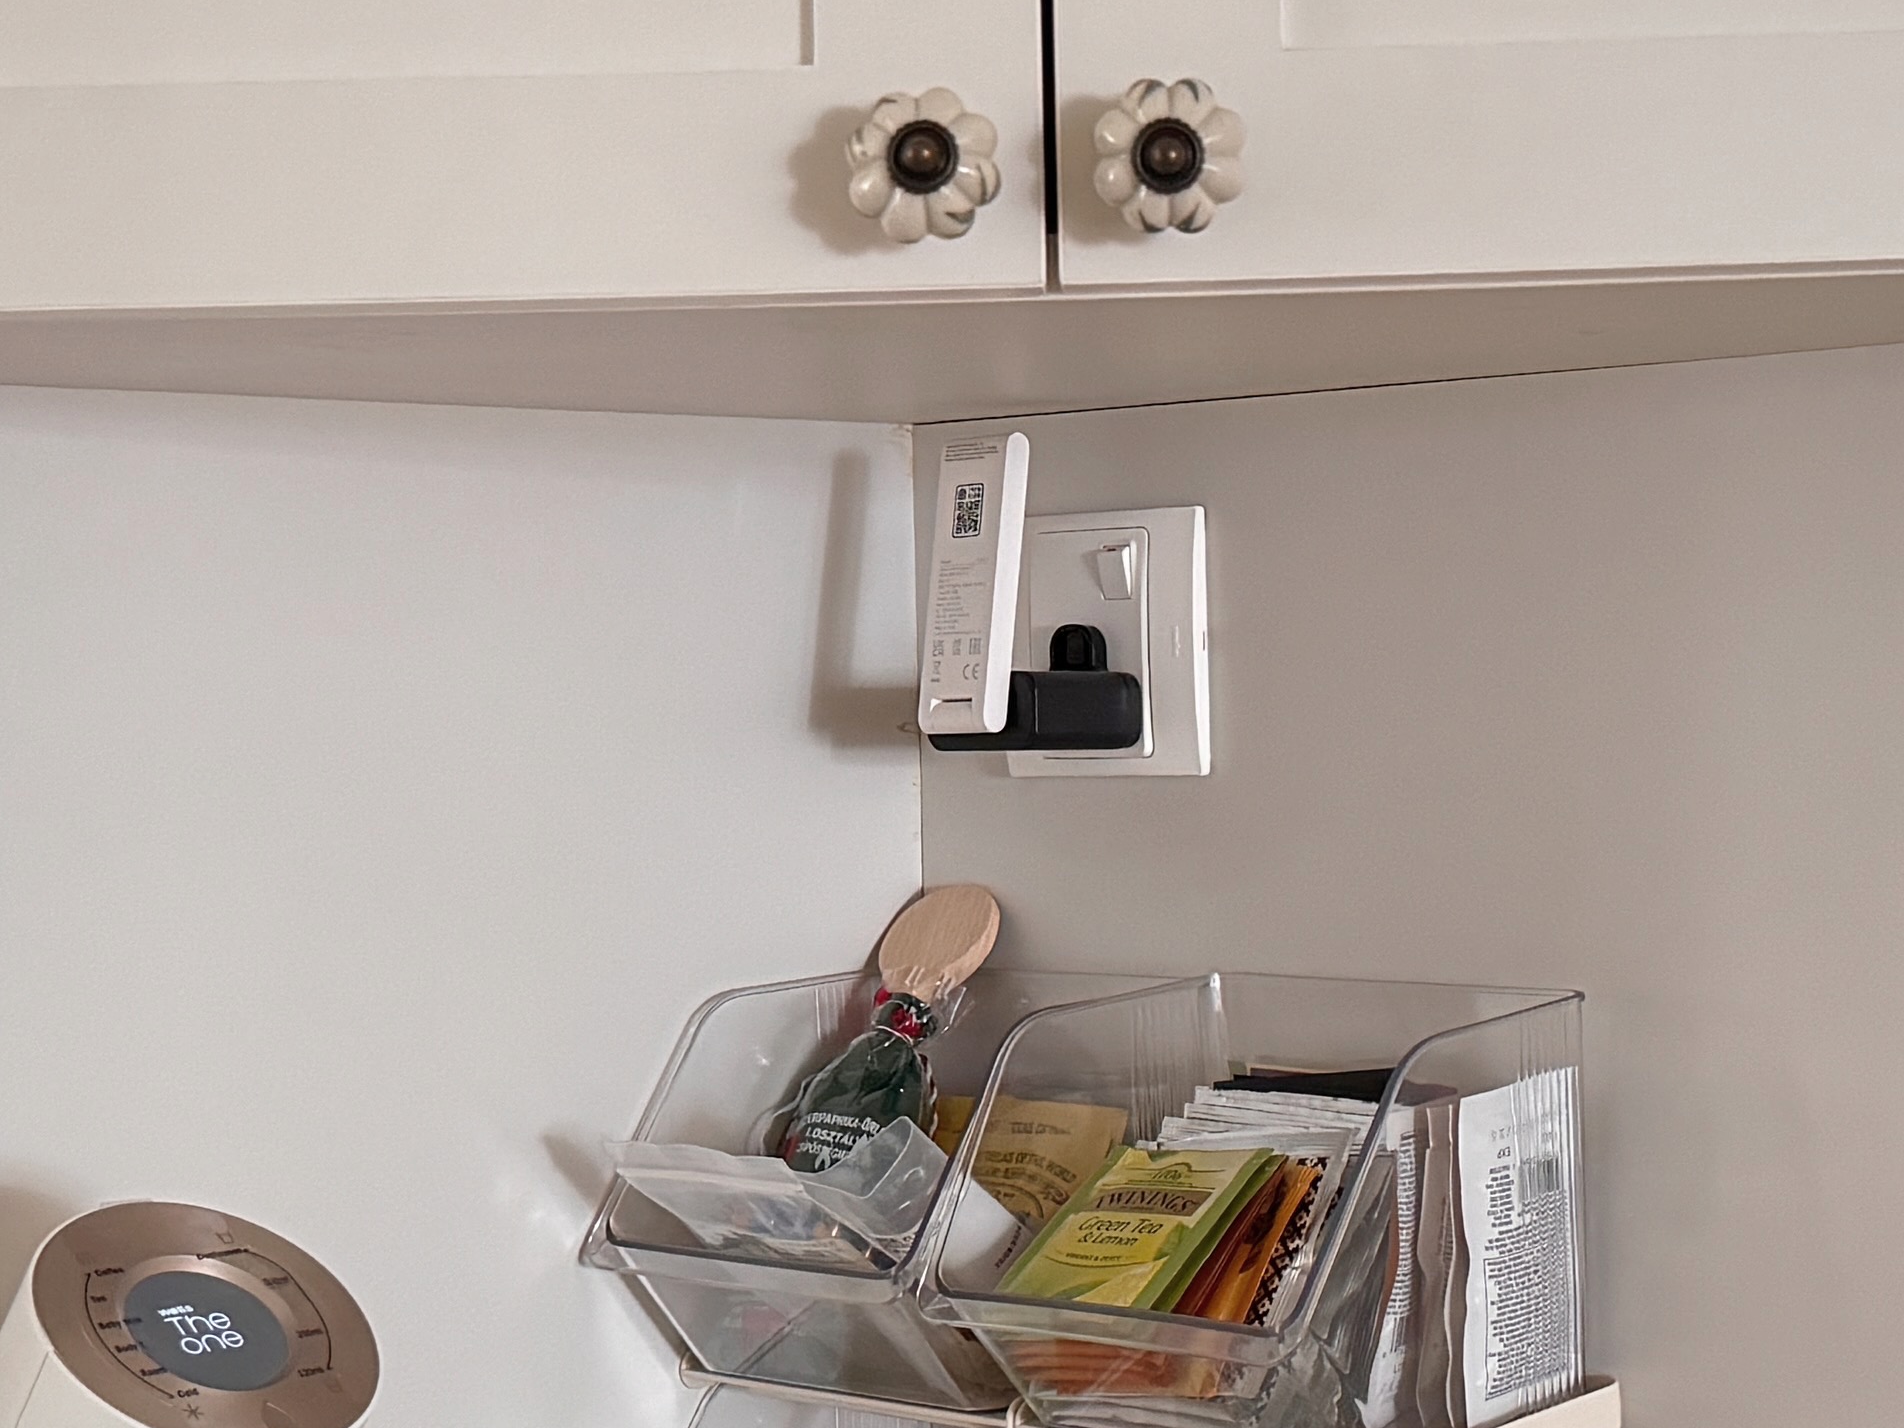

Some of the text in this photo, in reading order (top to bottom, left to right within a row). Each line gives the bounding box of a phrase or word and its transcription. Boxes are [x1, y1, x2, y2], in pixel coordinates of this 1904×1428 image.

[1097, 1191, 1196, 1213] TWININGS
[1079, 1216, 1163, 1235] Green Tea
[1091, 1232, 1139, 1247] Lemon
[163, 1312, 231, 1335] The
[180, 1330, 245, 1355] one
